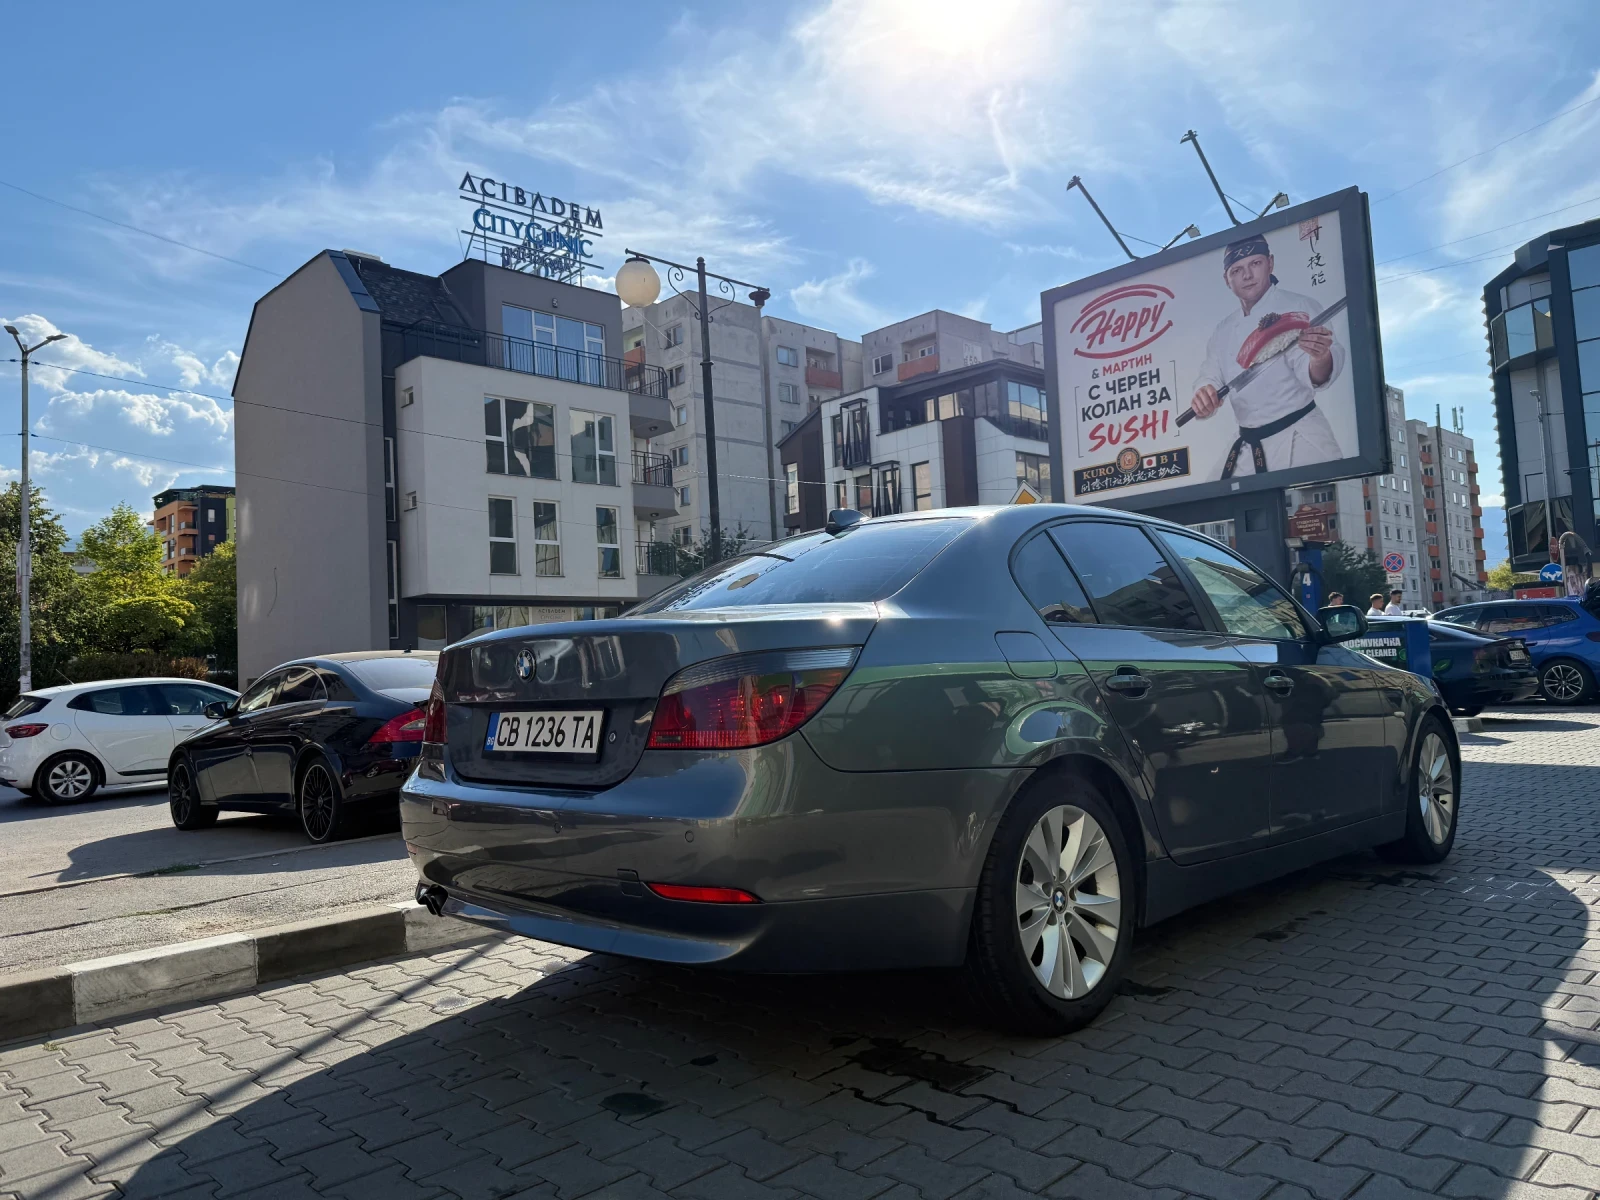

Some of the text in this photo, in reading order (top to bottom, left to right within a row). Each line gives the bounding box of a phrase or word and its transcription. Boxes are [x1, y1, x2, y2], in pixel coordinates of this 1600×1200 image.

[459, 171, 603, 229] ACIBADEM
[1080, 301, 1166, 349] Happy
[1091, 353, 1152, 379] & МАРТИН
[1088, 368, 1160, 400] С ЧЕРЕН
[1081, 386, 1172, 422] КОЛАН ЗА
[1088, 409, 1169, 452] SUSHI
[1082, 465, 1115, 480] KURO
[1302, 573, 1312, 586] 4
[1366, 648, 1397, 657] CLEANER
[497, 716, 595, 748] CB 1236 TA
